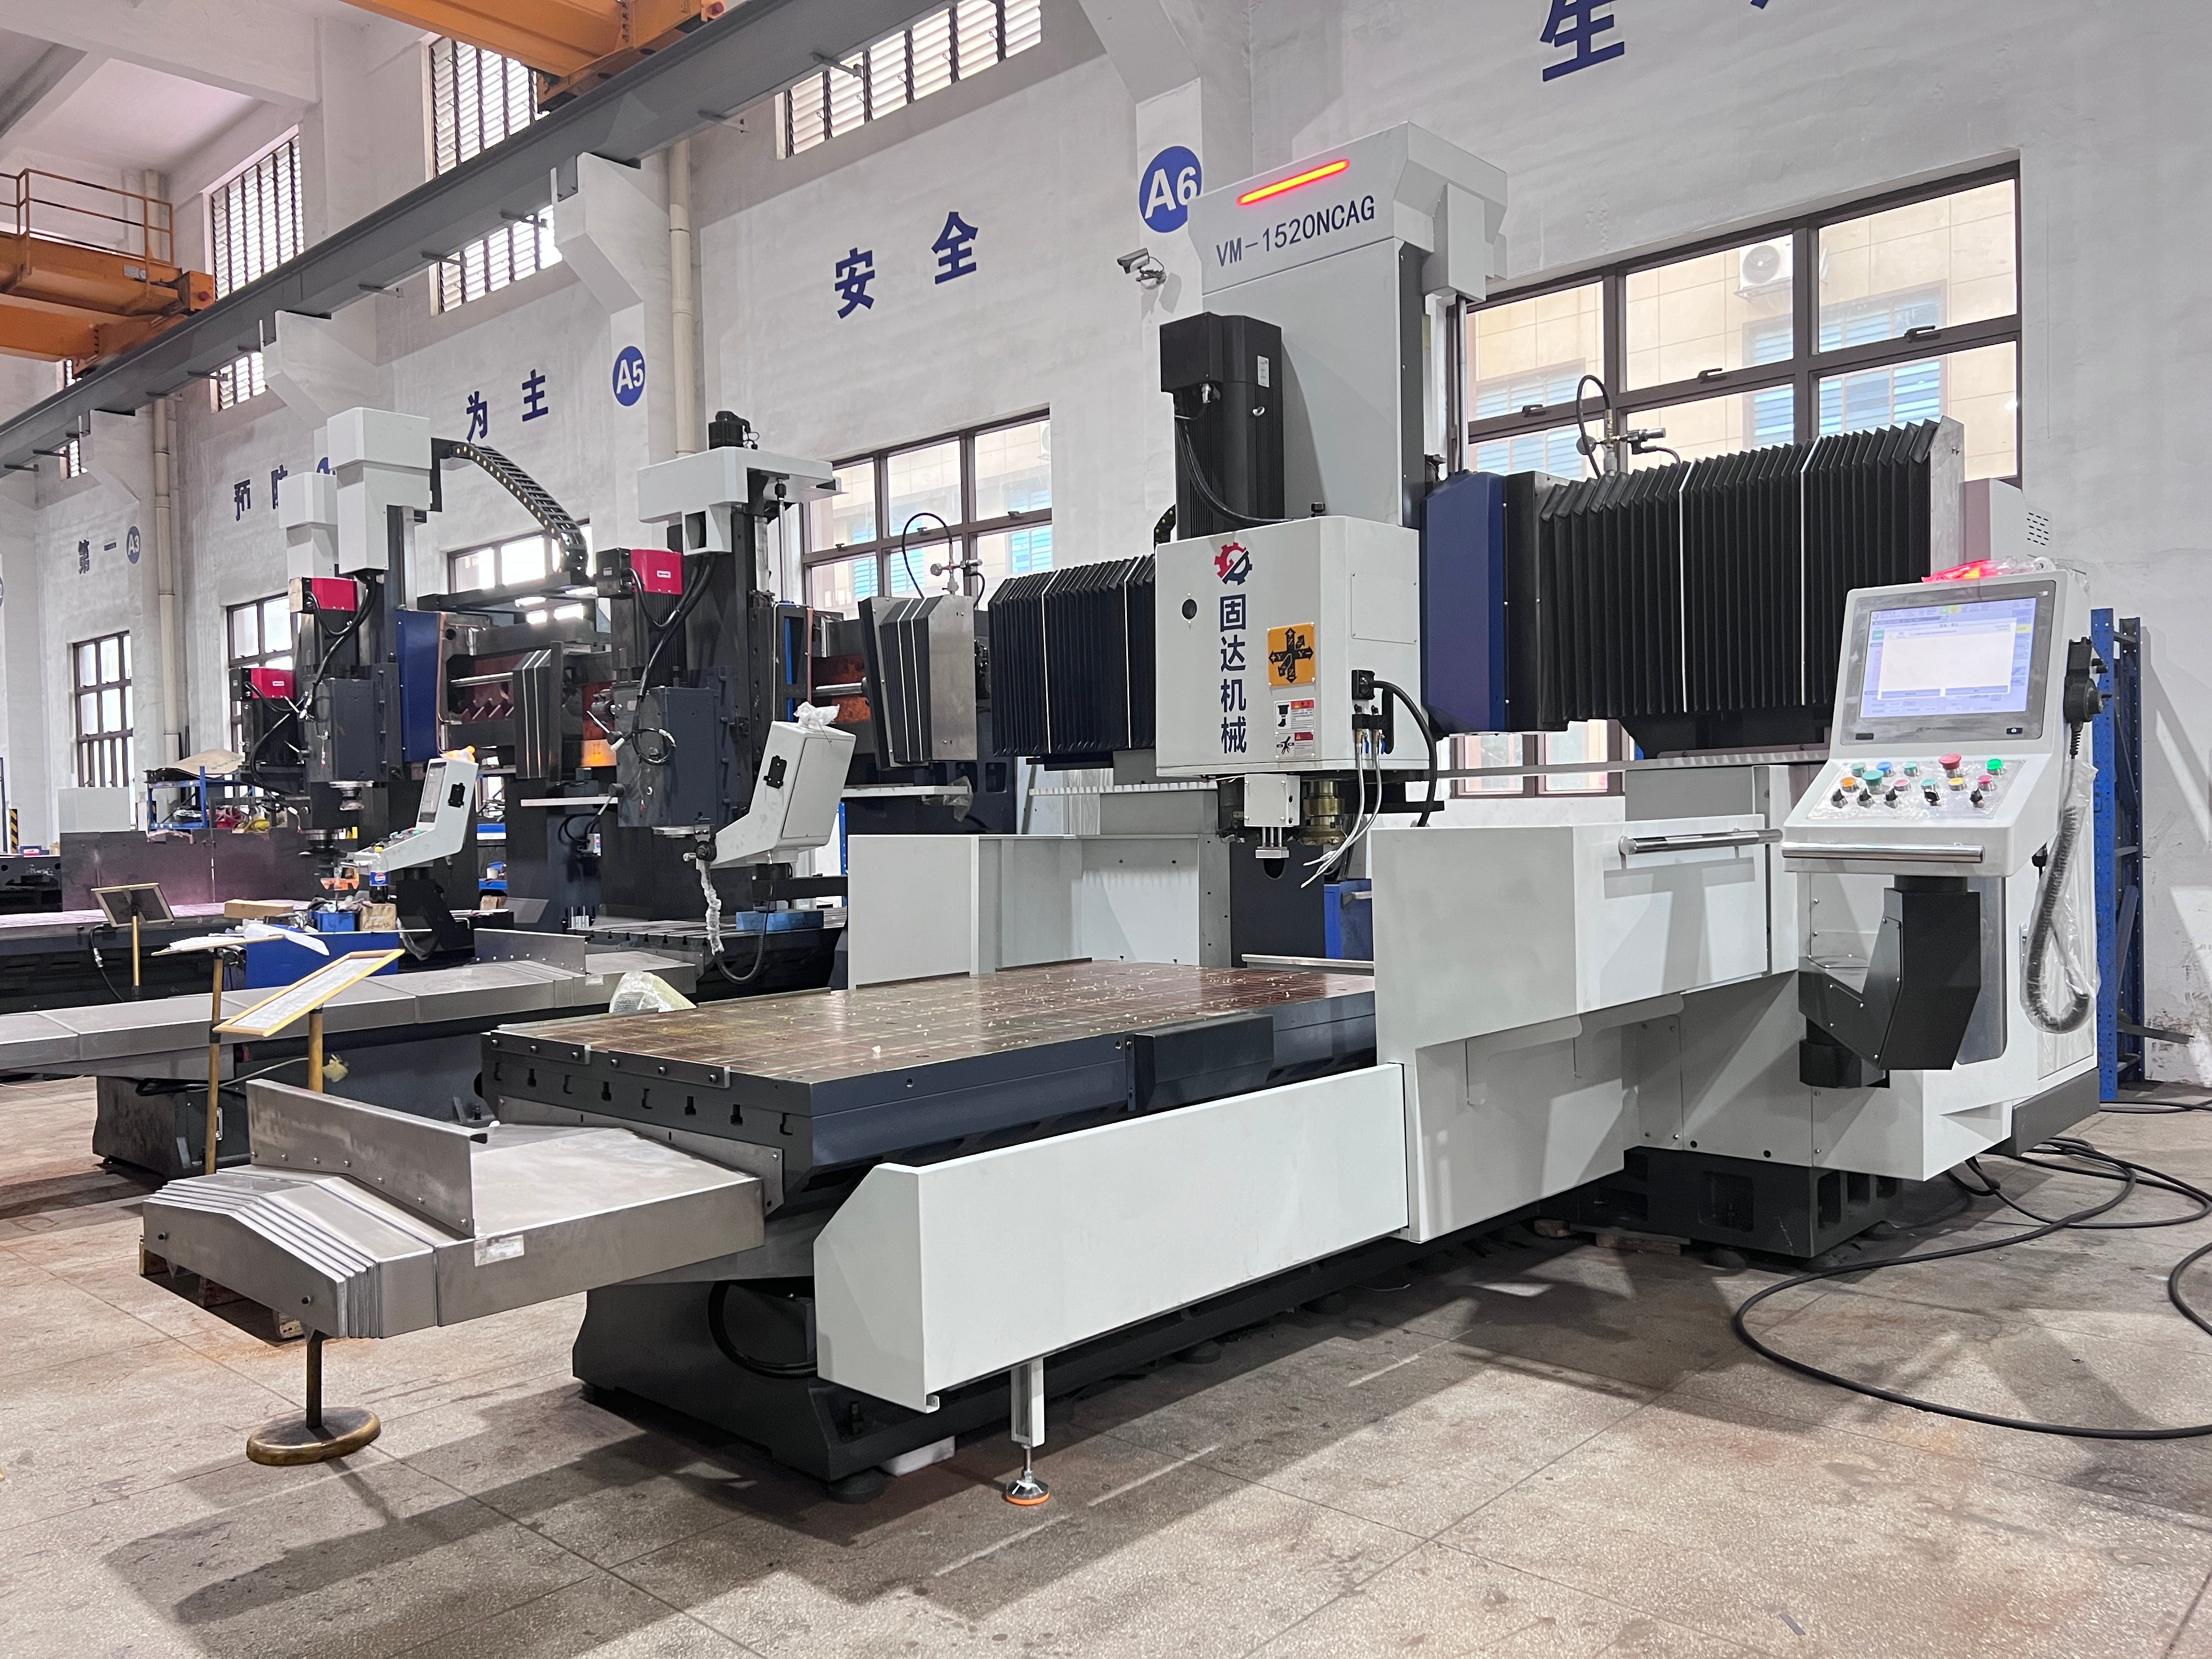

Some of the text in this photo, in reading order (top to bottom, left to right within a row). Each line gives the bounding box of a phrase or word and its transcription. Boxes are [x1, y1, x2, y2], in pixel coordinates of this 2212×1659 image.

[1144, 166, 1198, 219] A6
[1216, 195, 1375, 267] VM-1520NCAG
[834, 211, 979, 319] 安全
[616, 358, 644, 394] A5
[128, 534, 139, 555] A3
[1220, 594, 1247, 754] 固达机械
